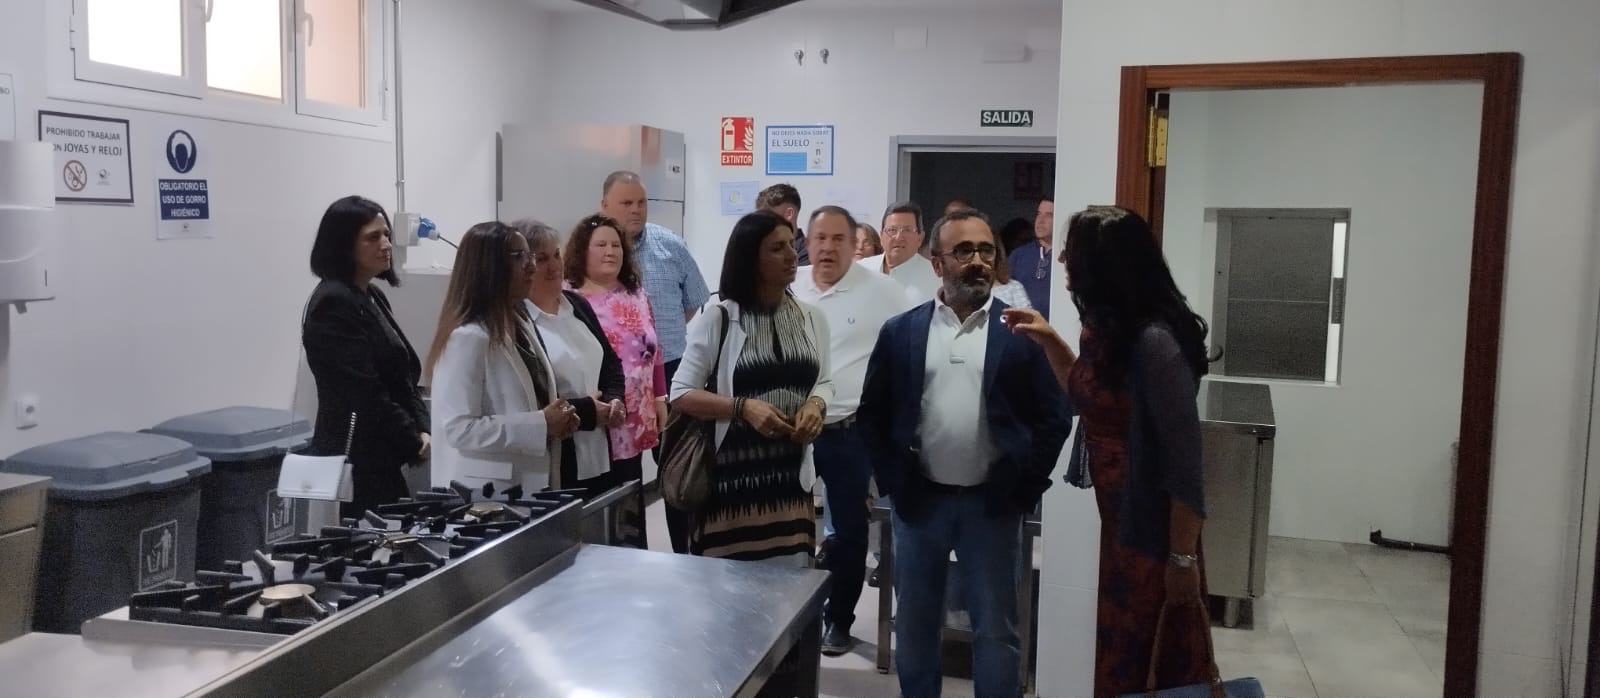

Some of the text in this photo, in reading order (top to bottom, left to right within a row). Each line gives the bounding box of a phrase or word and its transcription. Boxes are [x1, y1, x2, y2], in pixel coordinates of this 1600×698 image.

[982, 111, 1031, 124] SALIDA
[46, 126, 120, 140] PROHIBIDO TRABAJAR
[772, 139, 810, 147] EL SUELO
[64, 142, 89, 154] JOYAS
[91, 145, 97, 154] Y
[98, 145, 122, 156] RELOJ
[722, 154, 753, 165] EXTINTOR
[160, 182, 207, 191] OBLIGATORIO EL
[162, 195, 207, 204] USO DE GORRO
[170, 207, 201, 217] HIGIÉNICO
